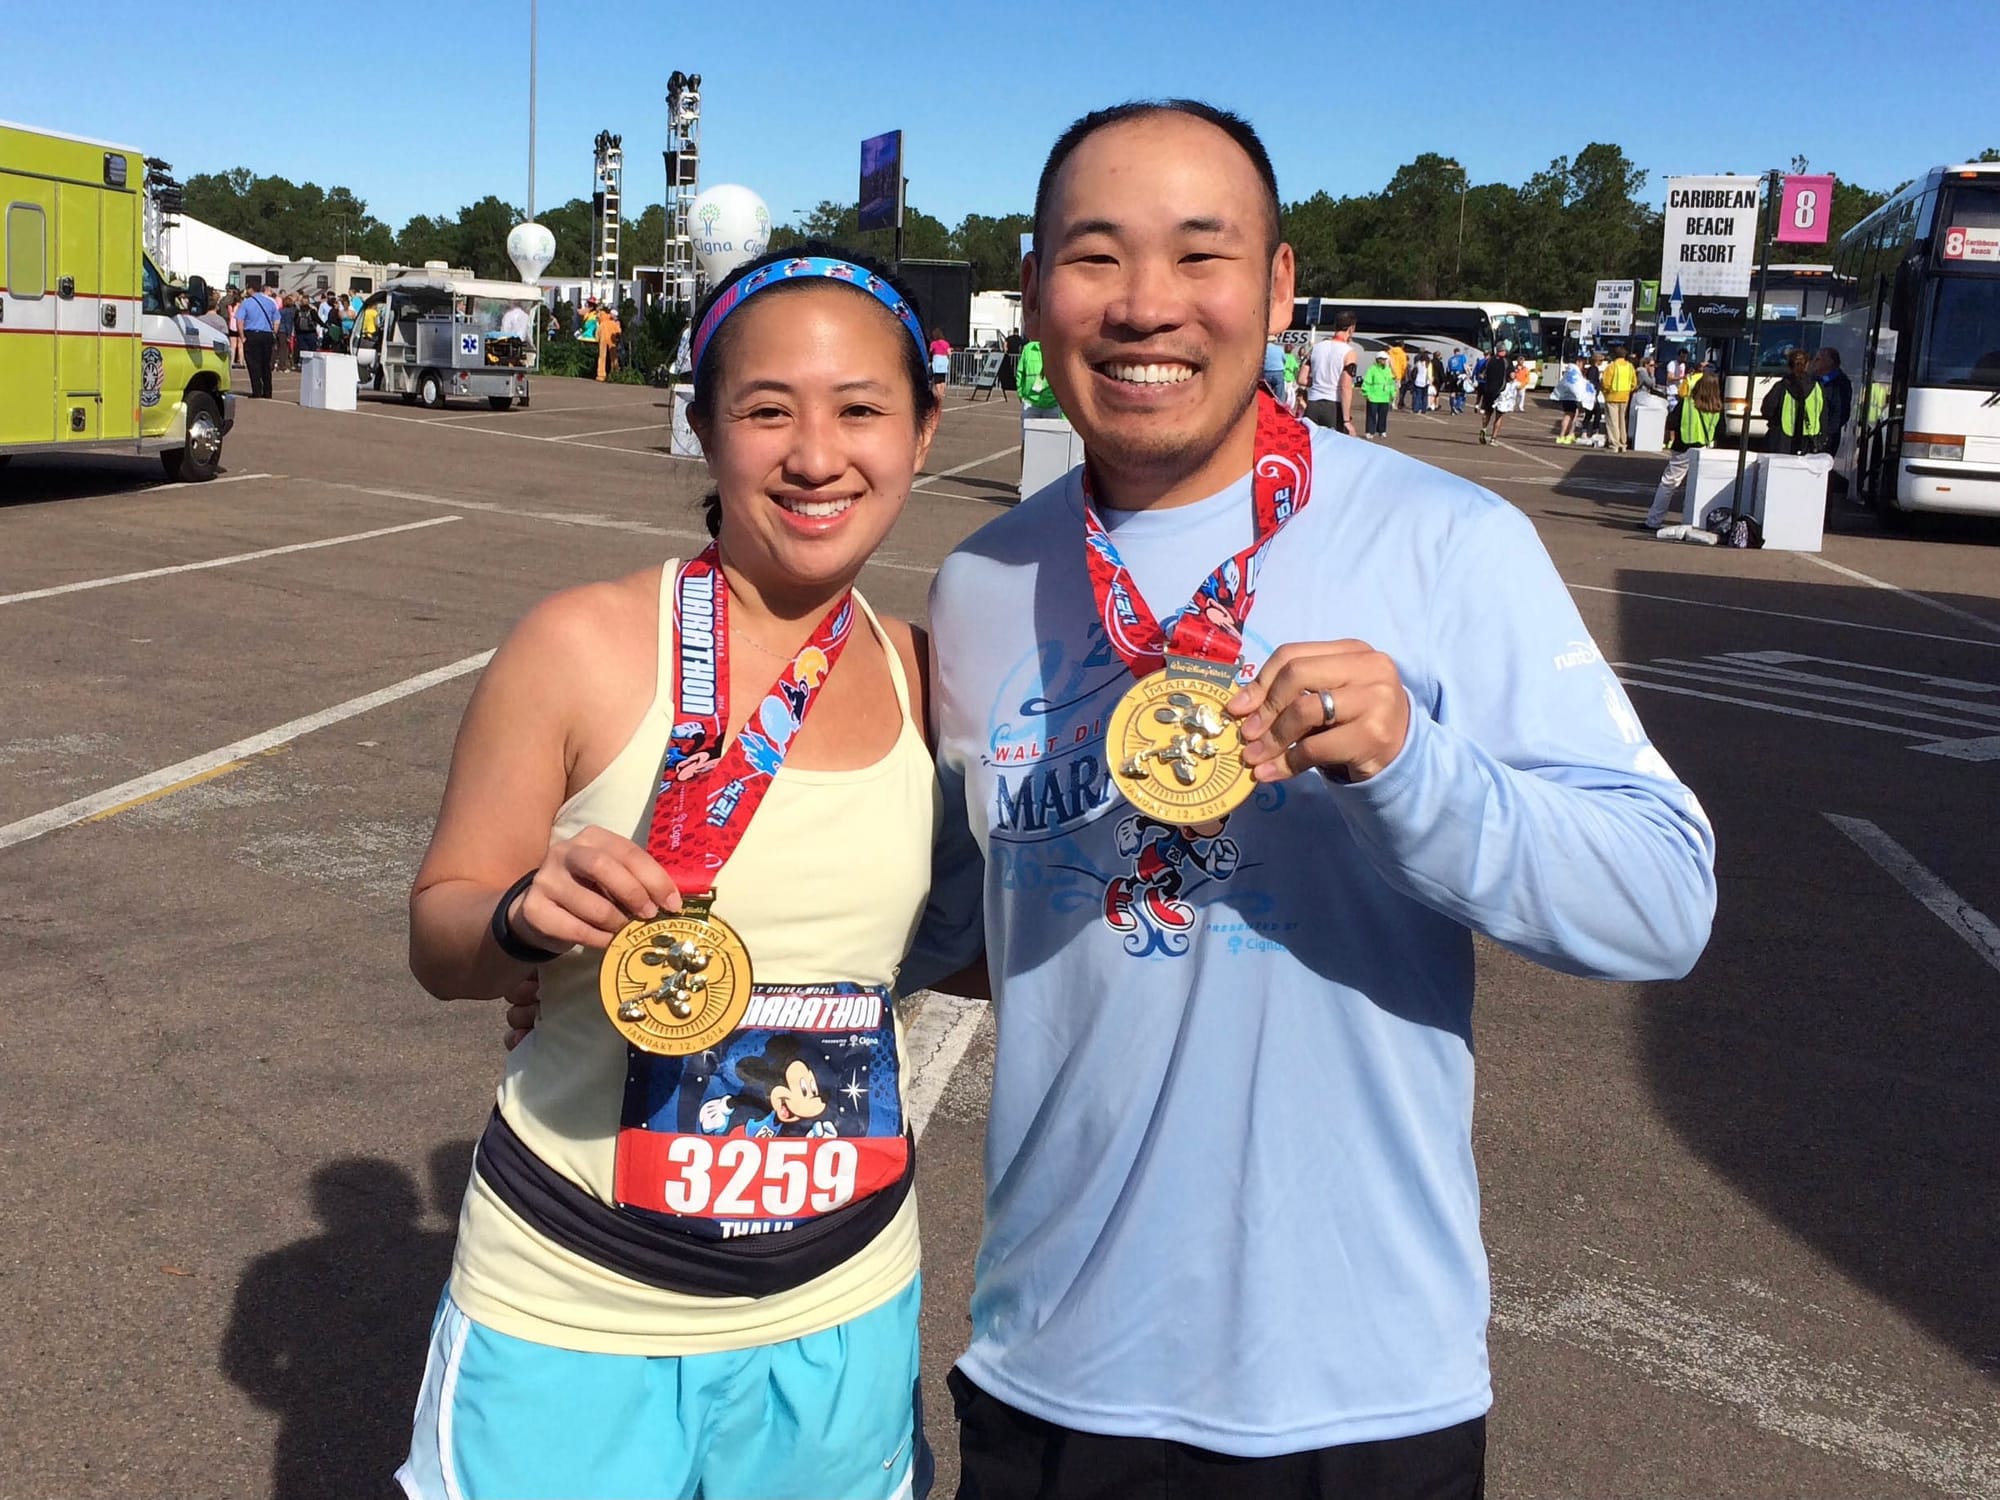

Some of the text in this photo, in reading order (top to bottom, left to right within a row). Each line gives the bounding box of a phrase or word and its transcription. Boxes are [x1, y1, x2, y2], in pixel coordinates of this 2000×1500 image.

[1670, 190, 1757, 209] CARIBBEAN
[1794, 190, 1817, 229] 8
[1686, 217, 1735, 236] BEACH
[692, 238, 733, 256] Cigna
[1679, 244, 1736, 263] RESORT
[1946, 232, 1963, 255] 8
[681, 566, 716, 717] MARATHON
[995, 737, 1058, 761] WALT
[706, 779, 746, 828] 1.12.14
[766, 986, 801, 994] DISNEY
[804, 986, 835, 995] WORLD
[738, 995, 882, 1029] MARATHON
[624, 1026, 673, 1052] JANUARY
[700, 1028, 725, 1045] 2014
[664, 1136, 859, 1216] 3259
